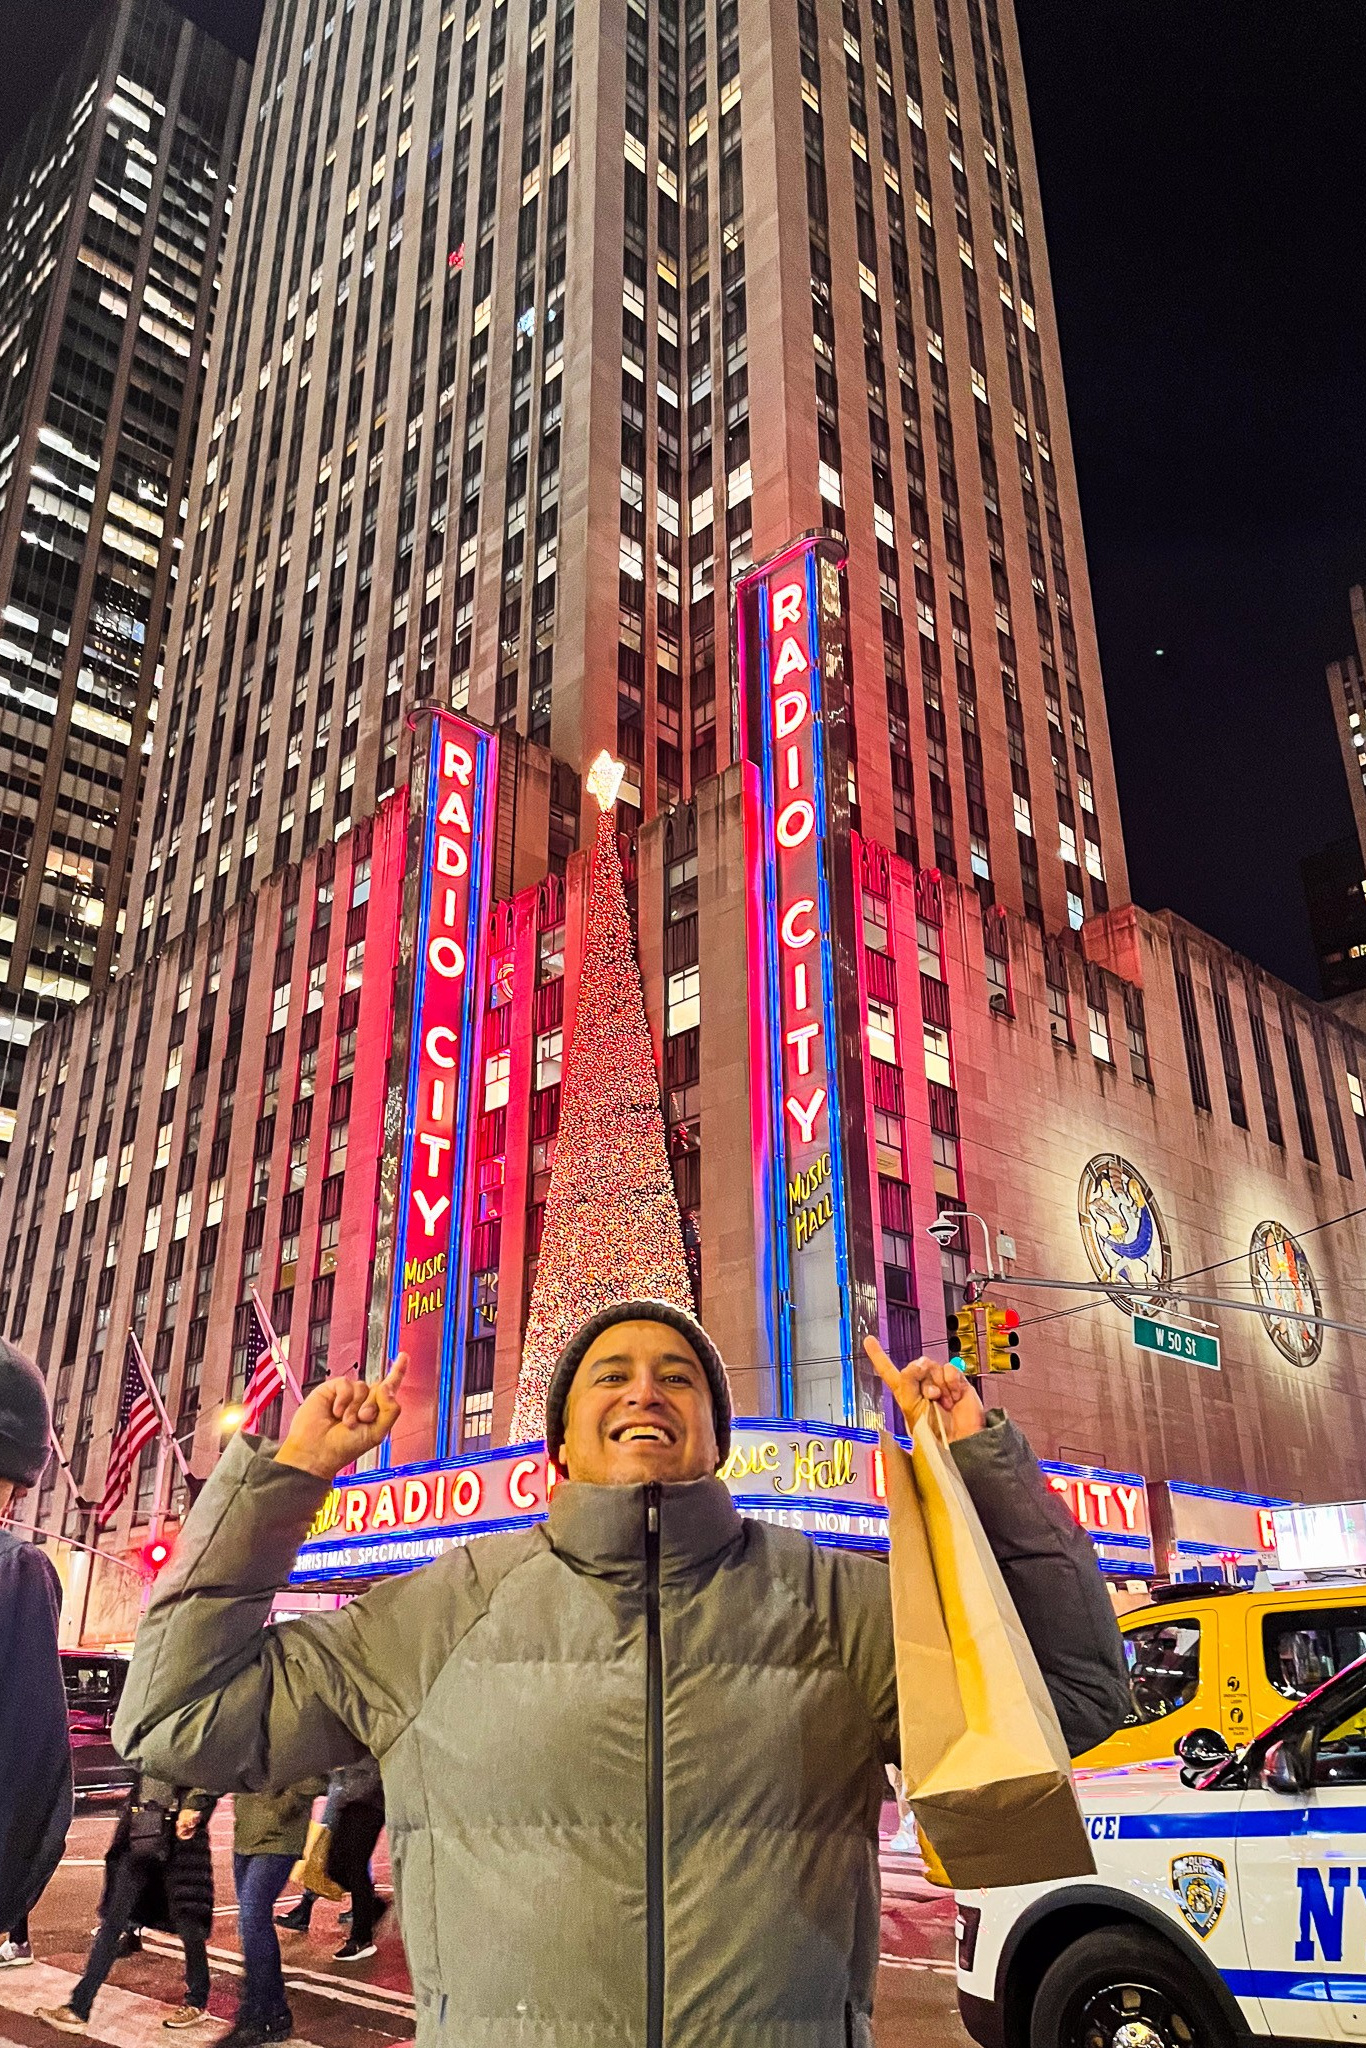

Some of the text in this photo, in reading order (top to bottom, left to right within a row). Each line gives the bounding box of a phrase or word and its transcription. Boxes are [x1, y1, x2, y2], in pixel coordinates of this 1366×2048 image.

[772, 582, 827, 1143] RADIO CITY
[412, 740, 473, 1238] RADIO CITY
[1155, 1326, 1197, 1357] W 50 St
[306, 1488, 341, 1539] all
[345, 1470, 481, 1533] RADIO
[815, 1512, 850, 1534] NOW
[859, 1516, 889, 1537] PLA
[358, 1538, 443, 1564] SPECTACULAR
